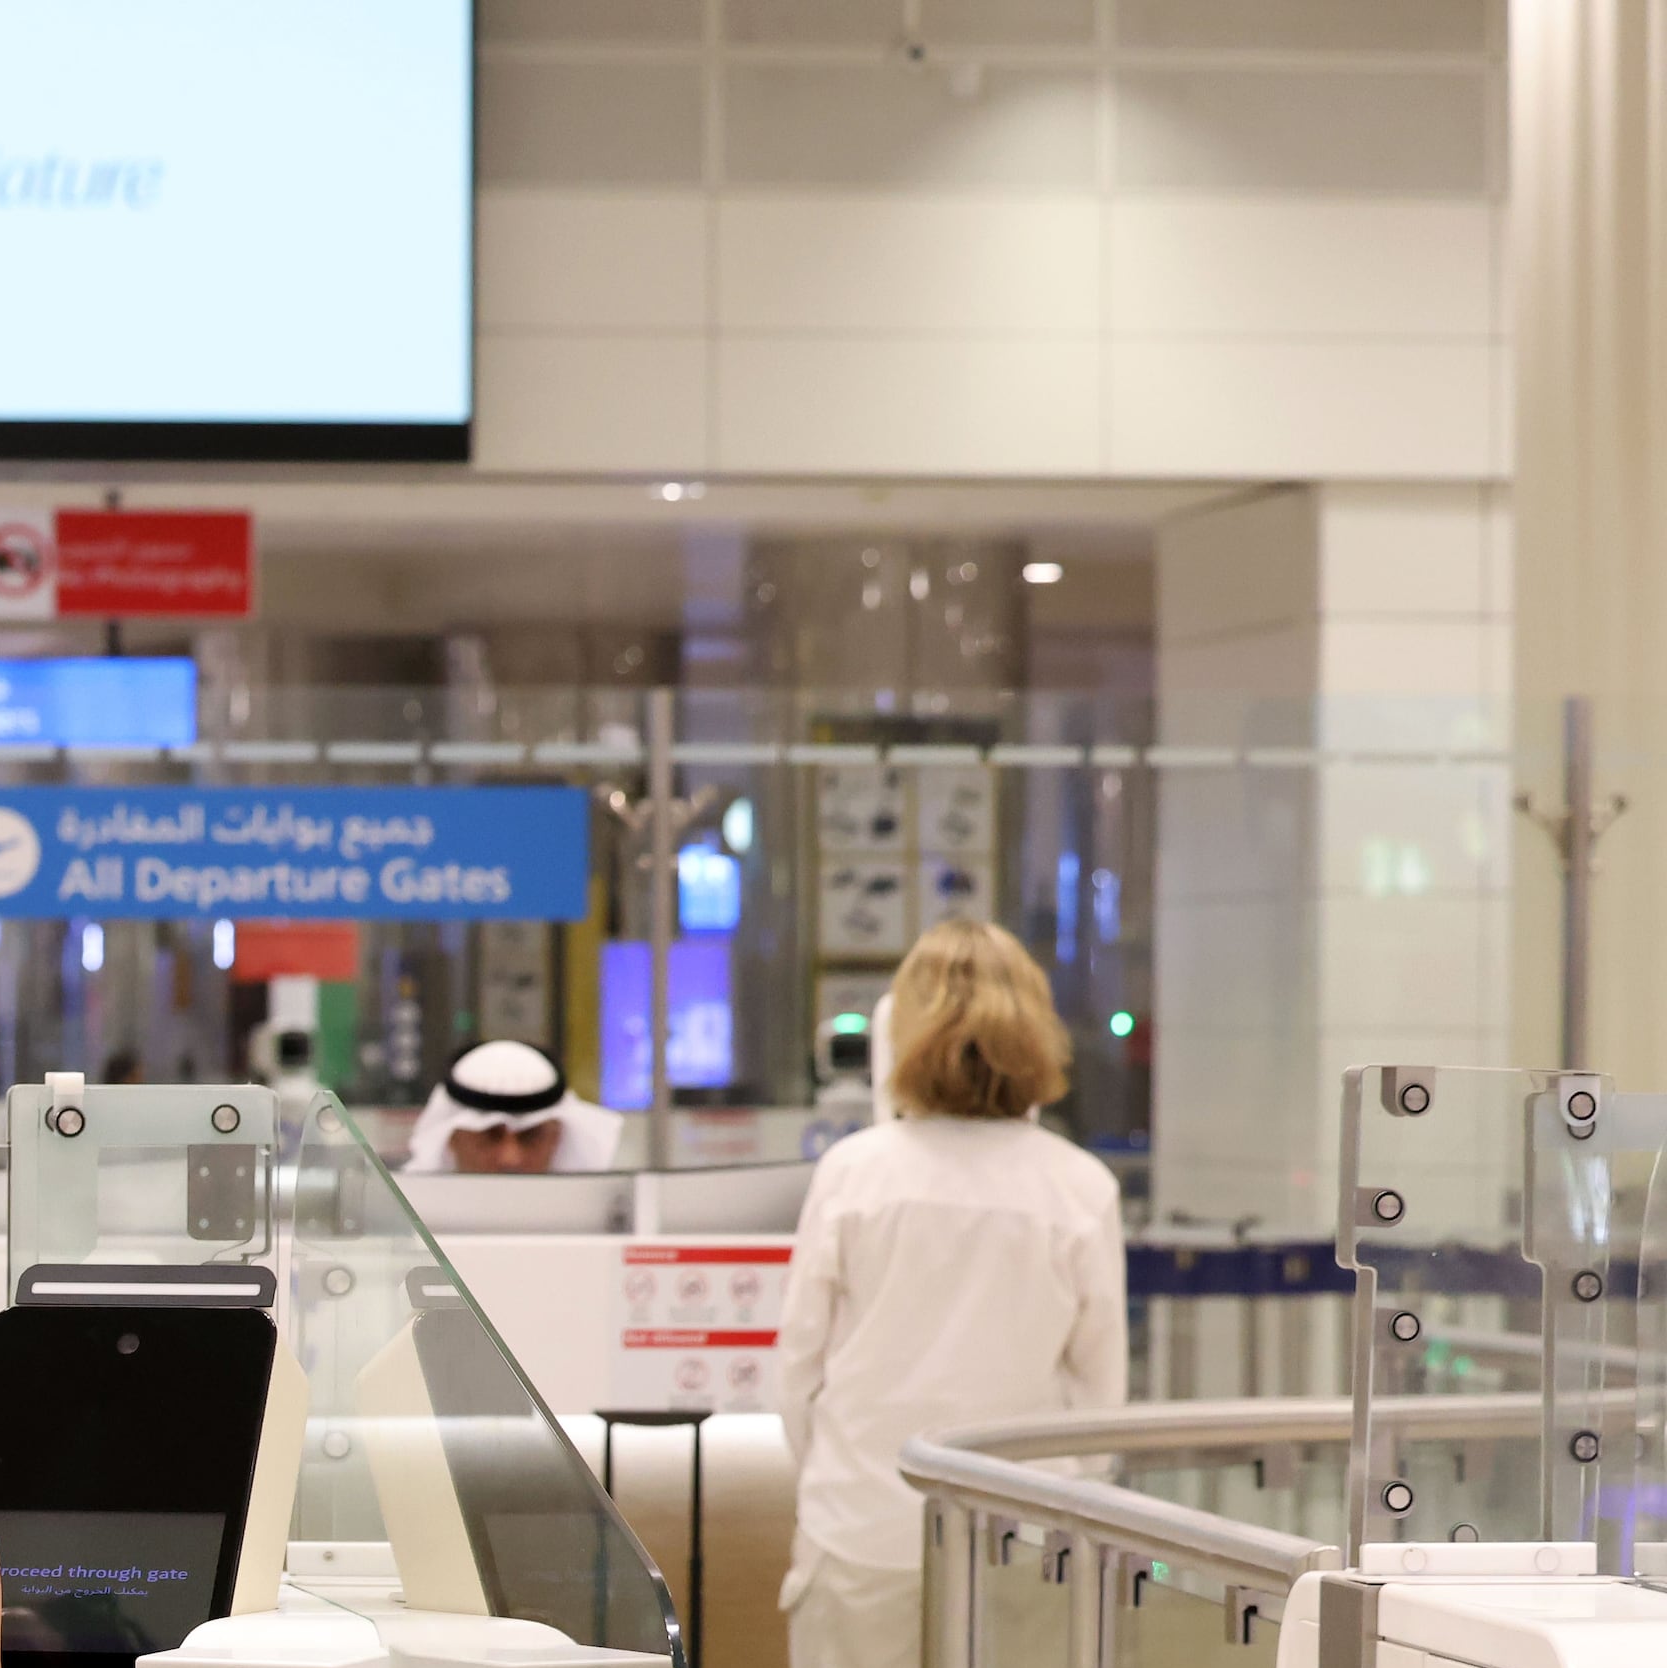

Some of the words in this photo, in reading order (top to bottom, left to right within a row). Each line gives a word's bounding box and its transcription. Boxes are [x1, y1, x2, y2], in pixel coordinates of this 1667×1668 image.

[57, 855, 125, 902] All
[134, 855, 371, 912] Departure
[379, 855, 512, 904] Gates
[0, 1565, 63, 1578] roceed
[68, 1565, 142, 1582] through
[147, 1568, 189, 1583] gate
